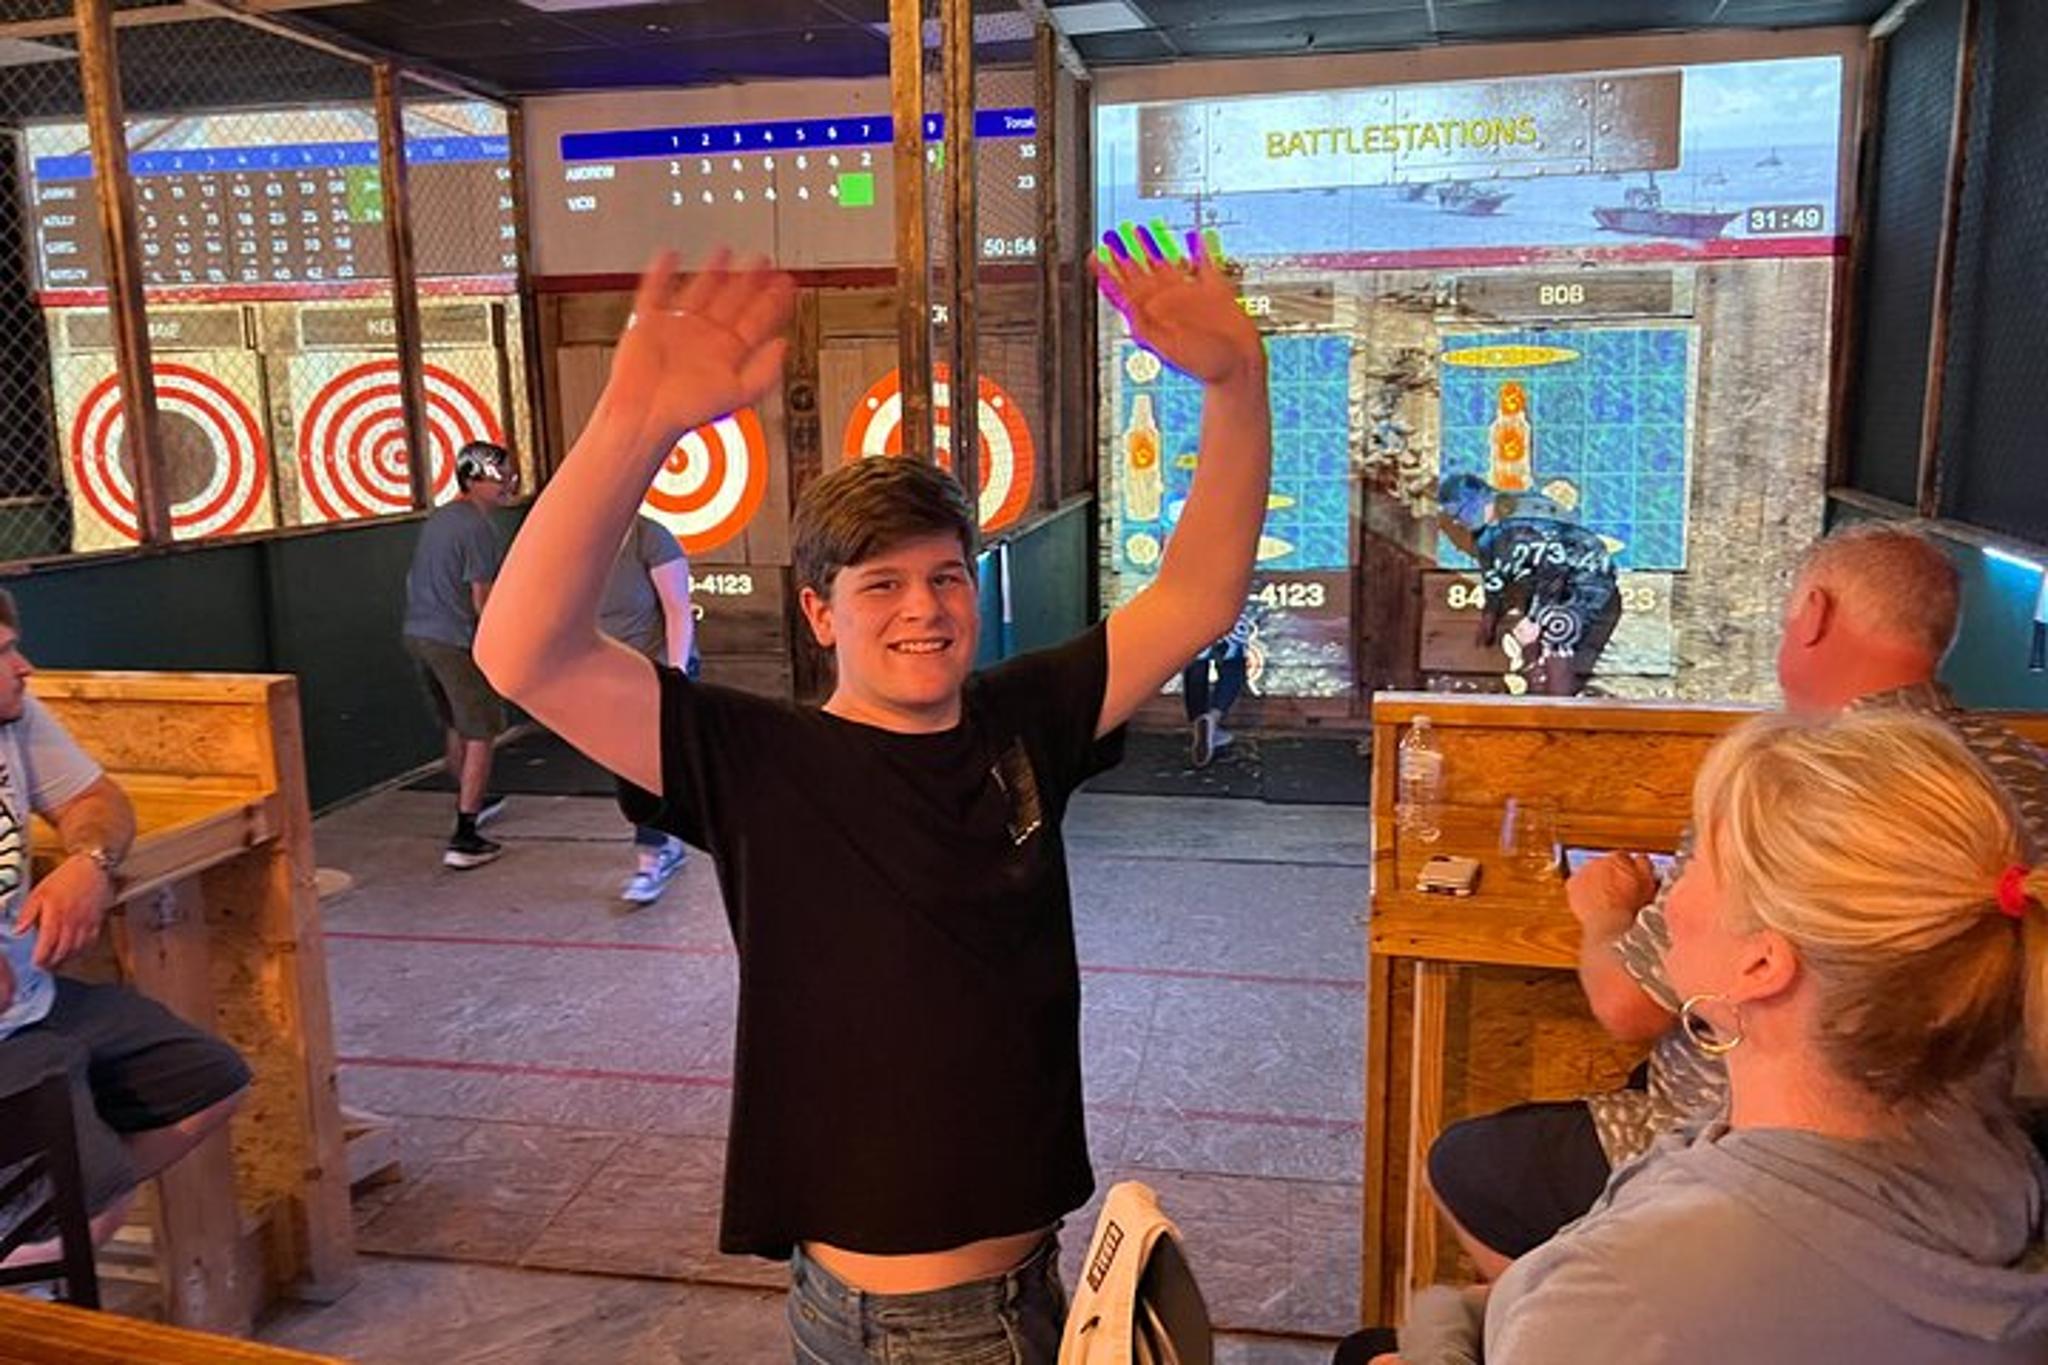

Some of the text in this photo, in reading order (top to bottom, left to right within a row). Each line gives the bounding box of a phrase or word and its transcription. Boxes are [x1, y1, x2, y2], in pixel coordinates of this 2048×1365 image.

[701, 133, 711, 146] 2
[733, 130, 742, 145] 3
[763, 130, 774, 143] 4
[827, 126, 838, 140] 6
[1265, 114, 1537, 159] BATTLESTATIONS
[670, 161, 681, 175] 2
[860, 151, 872, 167] 2
[1751, 208, 1820, 230] 31:49
[1539, 284, 1585, 304] BOB
[1236, 296, 1270, 316] ER
